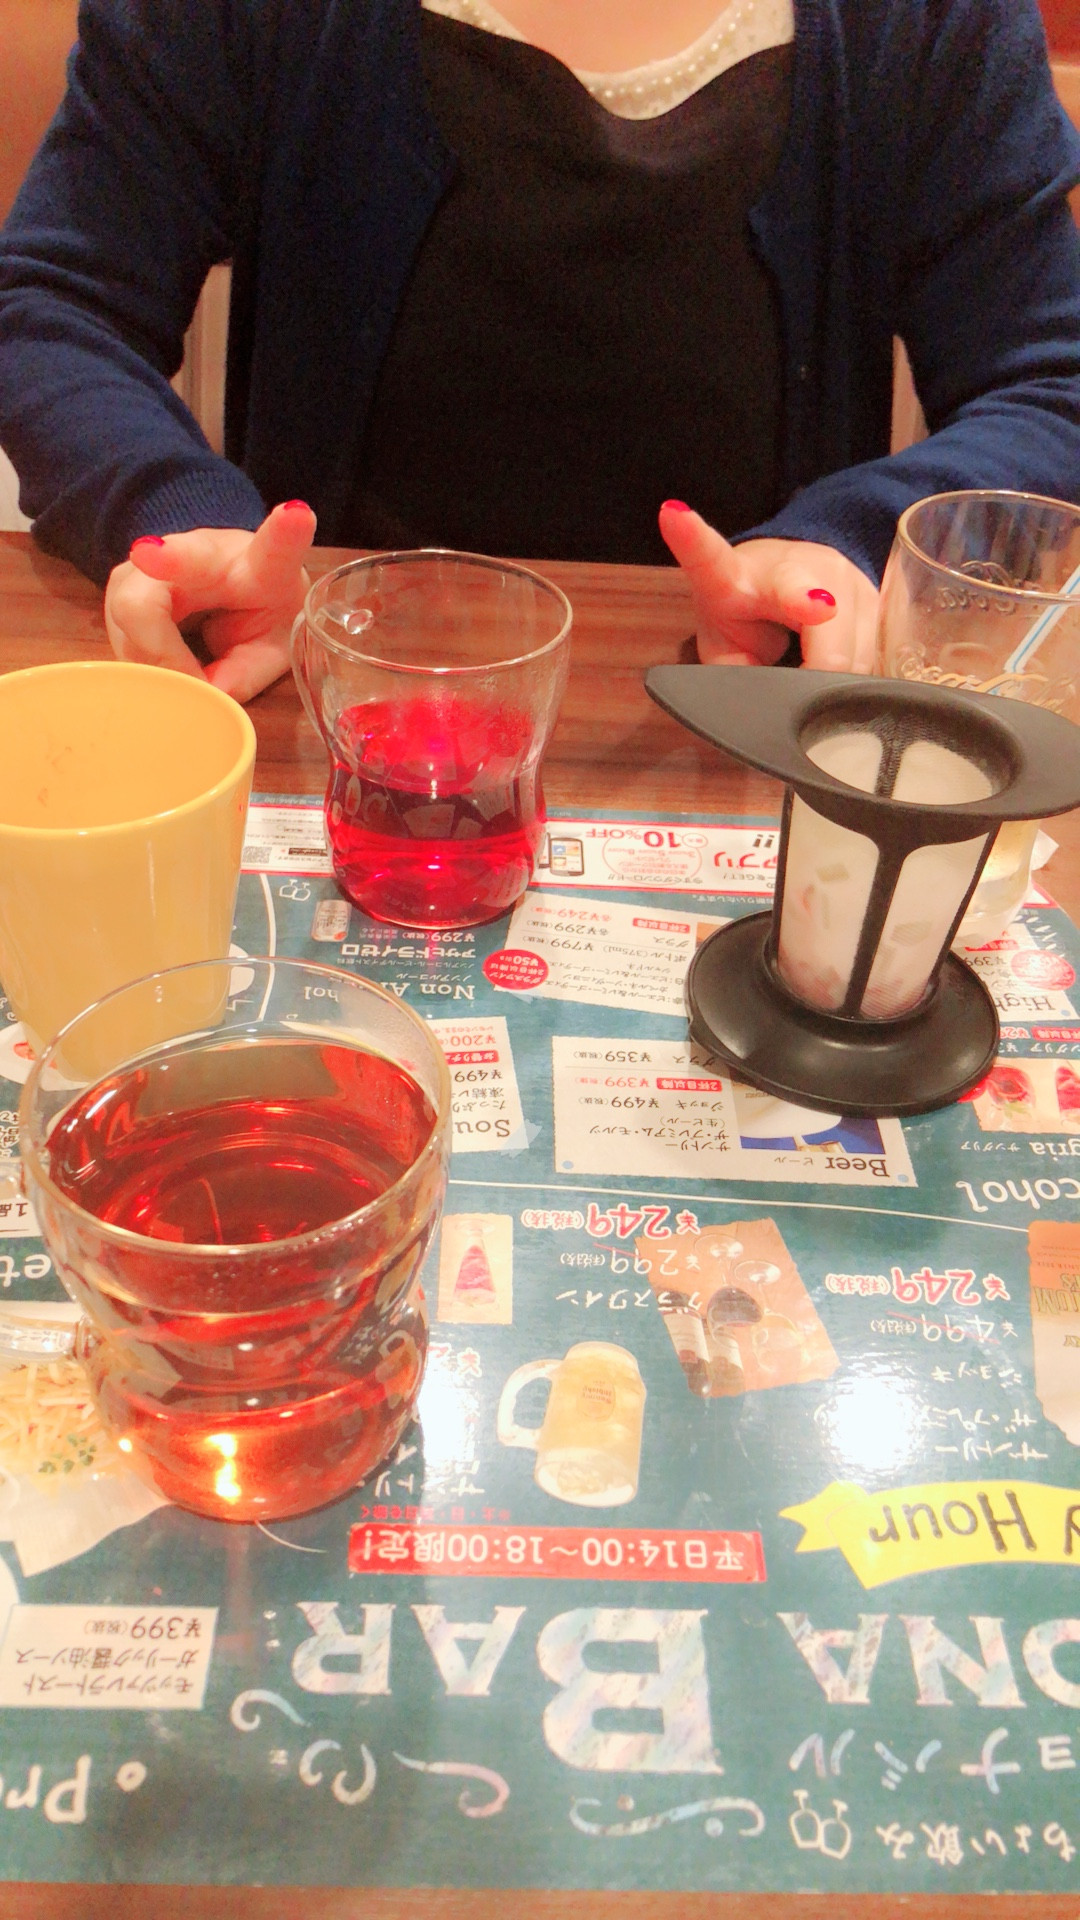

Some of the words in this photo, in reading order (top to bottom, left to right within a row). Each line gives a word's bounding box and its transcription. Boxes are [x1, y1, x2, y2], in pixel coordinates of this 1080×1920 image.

[341, 944, 476, 959] アサヒドライゼロ
[396, 973, 472, 982] ノンアルコール
[420, 983, 475, 1000] Non
[454, 1069, 501, 1083] ¥499
[675, 1099, 724, 1112] ジョッキ
[454, 1119, 510, 1138] Sou
[665, 1140, 730, 1152] サントリー
[960, 1141, 1020, 1152] サングリア
[774, 1157, 813, 1166] ビール
[825, 1157, 890, 1178] Beer
[555, 1289, 702, 1314] グラスワイン
[869, 1490, 1037, 1554] Hour
[16, 1647, 199, 1669] ガーリック醤油ソース
[23, 1674, 193, 1695] モッツァレラトースト
[292, 1602, 723, 1775] BAR
[0, 1754, 92, 1824] Pr
[875, 1822, 1076, 1866] ちょい飲み
